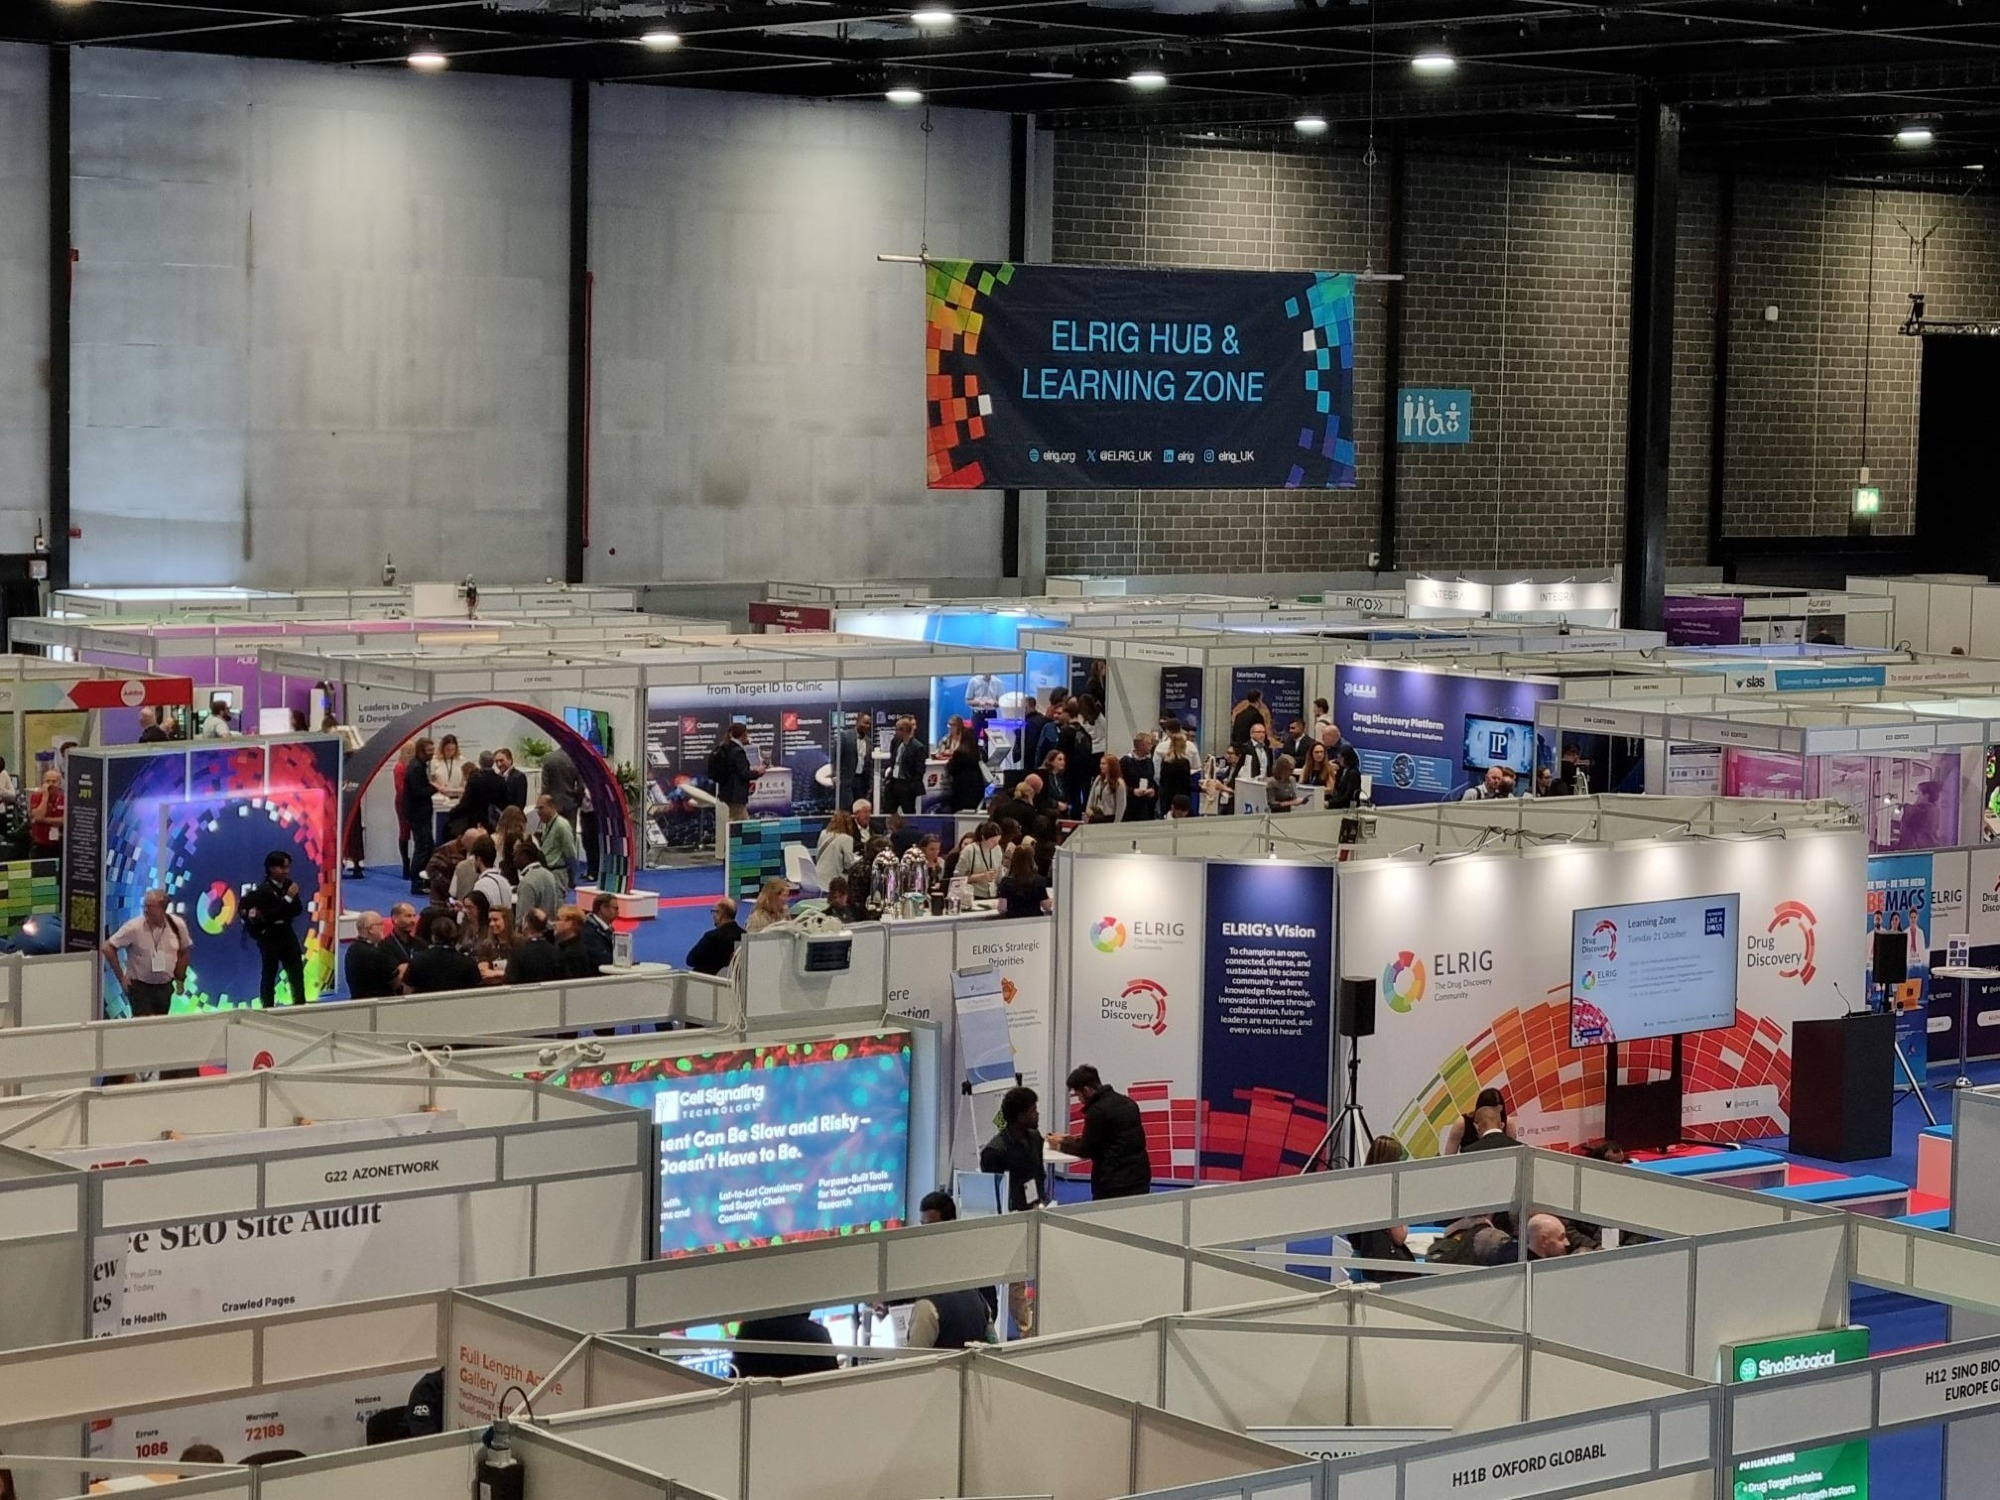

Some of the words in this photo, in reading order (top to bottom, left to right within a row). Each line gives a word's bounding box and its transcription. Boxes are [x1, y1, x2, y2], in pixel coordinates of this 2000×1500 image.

[1052, 321, 1139, 354] ELRIG
[1149, 323, 1212, 354] HUB
[1222, 324, 1240, 355] &
[1022, 369, 1177, 400] LEARNING
[1184, 371, 1264, 402] ZONE
[1043, 450, 1076, 464] elrig.org
[1100, 450, 1152, 462] @ELRIG_UK
[1177, 450, 1194, 464] elrig
[1218, 450, 1254, 463] elrig_UK
[707, 684, 731, 695] from
[734, 682, 766, 697] Target
[769, 682, 780, 693] ID
[784, 682, 792, 692] to
[796, 680, 822, 692] Clinic
[1746, 675, 1765, 688] slas
[358, 703, 390, 711] Leaders
[1352, 712, 1372, 724] Drug
[1372, 714, 1410, 728] Discovery
[1410, 718, 1444, 730] Platform
[1491, 734, 1507, 753] IP
[1982, 892, 1998, 902] Drug
[1134, 922, 1184, 936] ELRIG
[1628, 917, 1657, 929] Learning
[1659, 916, 1676, 925] Zone
[1222, 922, 1273, 937] ELRIG's
[1275, 924, 1316, 938] Vision
[1628, 934, 1651, 944] Tuesday
[1653, 932, 1661, 941] 21
[1662, 930, 1687, 940] October
[972, 943, 1003, 955] ELRIG's
[1005, 940, 1040, 953] Strategic
[1582, 936, 1597, 945] Drug
[1747, 935, 1774, 950] Drug
[1229, 947, 1238, 955] To
[1239, 948, 1275, 957] champion
[1582, 944, 1610, 954] Discovery
[988, 956, 1024, 968] Priorities
[1266, 959, 1296, 967] diverse,
[1434, 950, 1493, 976] ELRIG
[1747, 952, 1802, 968] Discovery
[1282, 968, 1310, 976] science
[1598, 970, 1617, 979] ELRIG
[1232, 978, 1274, 986] community
[1435, 981, 1446, 990] The
[1447, 980, 1462, 991] Drug
[1464, 978, 1492, 988] Discovery
[1225, 986, 1265, 996] knowledge
[1287, 988, 1310, 997] freely,
[1434, 992, 1468, 1001] Community
[1102, 998, 1127, 1010] Drug
[1218, 995, 1258, 1004] innovation
[1286, 998, 1316, 1007] through
[1101, 1010, 1153, 1022] Discovery
[1229, 1007, 1279, 1015] collaboration,
[1281, 1008, 1305, 1016] future
[1262, 1018, 1297, 1026] nurtured,
[1229, 1027, 1250, 1035] every
[680, 1090, 704, 1106] Cell
[705, 1084, 765, 1106] Signaling
[693, 1130, 726, 1148] Can
[728, 1126, 748, 1143] Be
[750, 1120, 786, 1142] Slow
[788, 1118, 818, 1136] and
[820, 1114, 858, 1134] Risky
[718, 1150, 756, 1169] Have
[760, 1147, 775, 1162] to
[778, 1144, 802, 1160] Be.
[324, 1170, 348, 1184] G22
[352, 1160, 440, 1180] AZONETWORK
[818, 1172, 868, 1188] Purpose-Built
[869, 1170, 888, 1181] Tools
[719, 1187, 757, 1201] Lot-to-Lot
[758, 1182, 803, 1198] Consistency
[818, 1188, 828, 1198] for
[829, 1186, 846, 1197] Your
[847, 1184, 862, 1195] Cell
[863, 1181, 893, 1194] Therapy
[719, 1202, 734, 1212] and
[735, 1198, 762, 1212] Supply
[762, 1196, 785, 1207] Chain
[818, 1199, 852, 1210] Research
[674, 1208, 690, 1218] and
[718, 1211, 757, 1225] Continuity
[160, 1222, 226, 1252] SEO
[237, 1214, 294, 1240] Site
[300, 1202, 382, 1233] Audit
[222, 1299, 263, 1313] Crawled
[265, 1295, 296, 1310] Pages
[134, 1311, 167, 1324] Health
[460, 1346, 480, 1364] Full
[482, 1354, 522, 1382] Length
[460, 1367, 498, 1397] Gallery
[1925, 1370, 1946, 1385] H12
[1951, 1366, 1978, 1380] SINO
[1945, 1382, 1988, 1401] EUROPE
[355, 1395, 381, 1405] Notices
[246, 1412, 279, 1422] Warnings
[136, 1428, 158, 1439] Errors
[245, 1424, 284, 1441] 72189
[135, 1442, 169, 1458] 1086
[1452, 1468, 1486, 1488] H11B
[1492, 1456, 1546, 1479] OXFORD
[1549, 1443, 1606, 1468] GLOBABL
[1748, 1483, 1767, 1493] Drug
[1768, 1477, 1792, 1490] Target
[1792, 1472, 1822, 1486] Proteins
[1802, 1488, 1828, 1500] Growth
[1828, 1485, 1856, 1497] Factors
